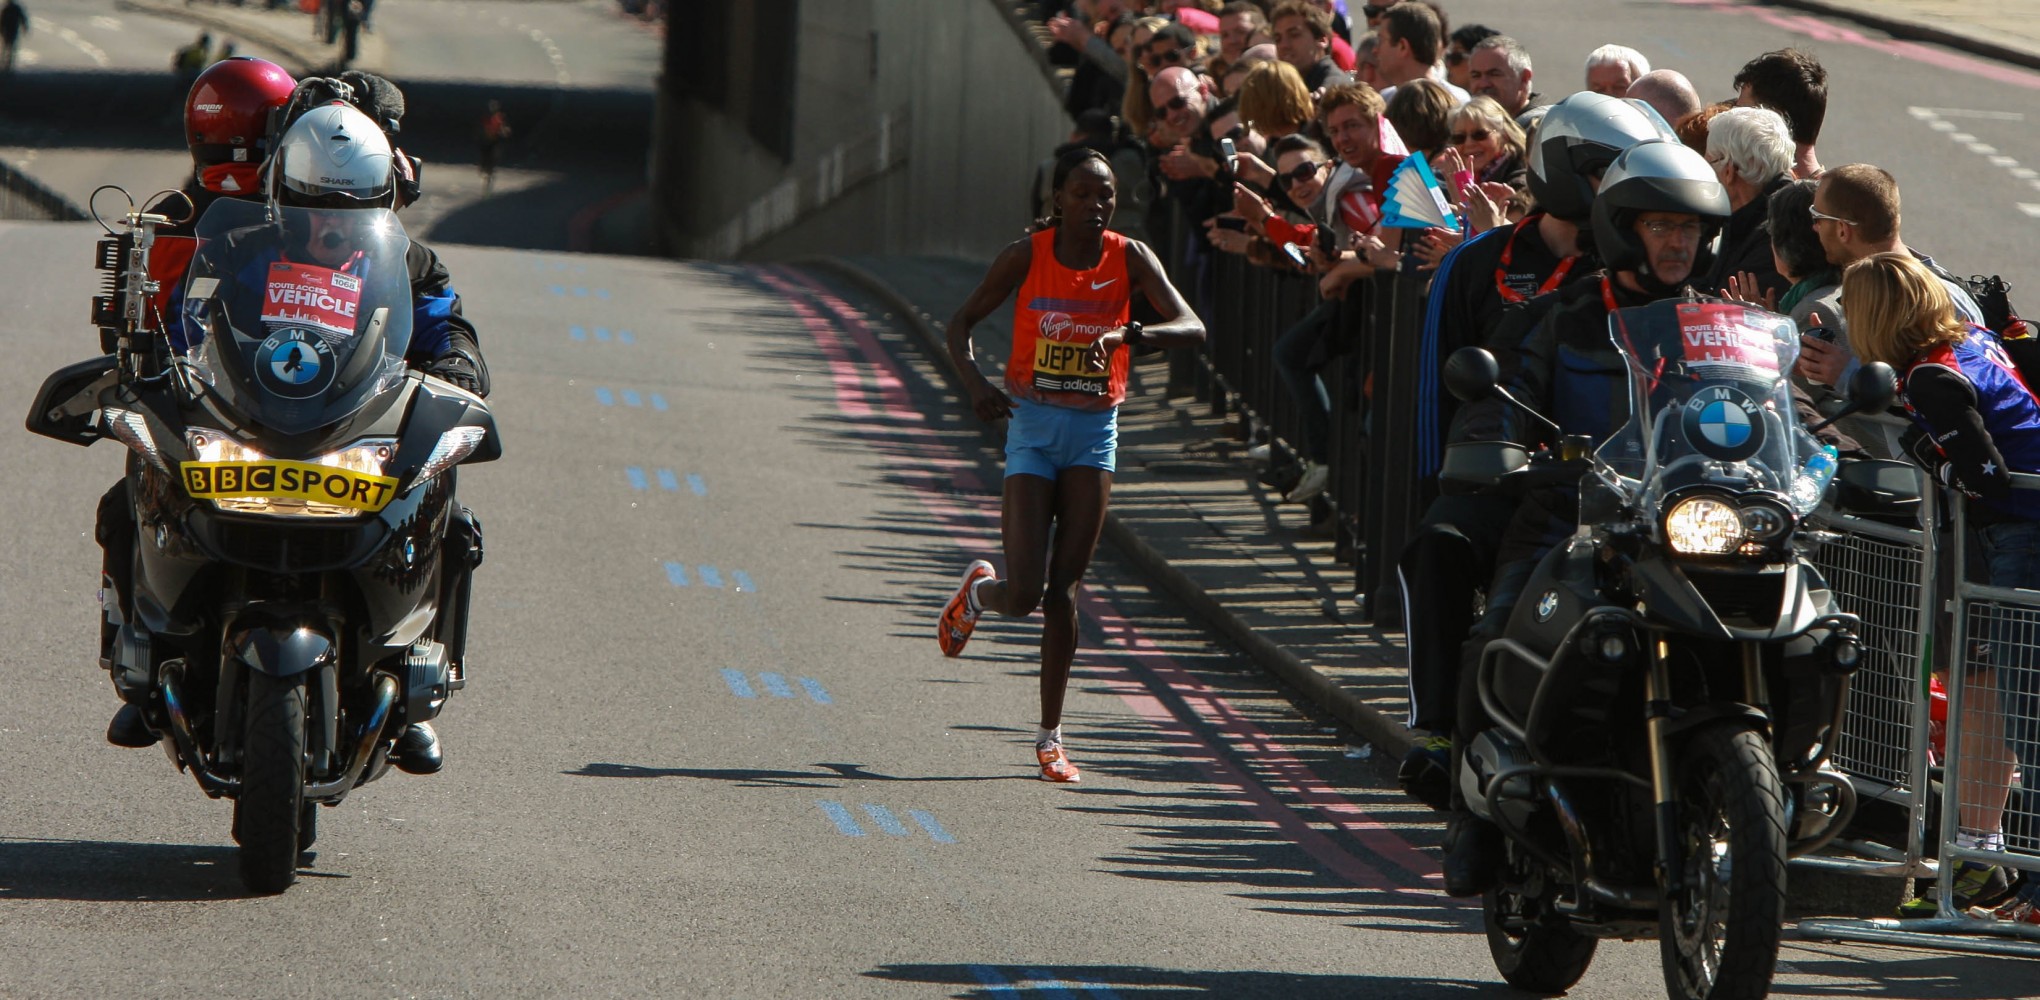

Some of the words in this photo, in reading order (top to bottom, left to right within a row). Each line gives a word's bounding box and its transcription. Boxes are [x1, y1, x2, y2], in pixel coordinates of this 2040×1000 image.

[196, 103, 224, 113] NOLAN
[320, 176, 356, 186] SHARK
[268, 282, 295, 290] ROUTE
[296, 284, 329, 295] ACCESS
[334, 279, 355, 290] 1068
[268, 288, 356, 318] VEHICLE
[1041, 313, 1071, 340] Virgin
[1683, 324, 1712, 332] ROUTE
[264, 329, 330, 355] BMW
[1038, 344, 1110, 372] JEPT
[1063, 379, 1102, 392] adidas
[1689, 388, 1758, 414] BMW
[185, 465, 276, 493] BBC
[280, 468, 393, 506] SPORT
